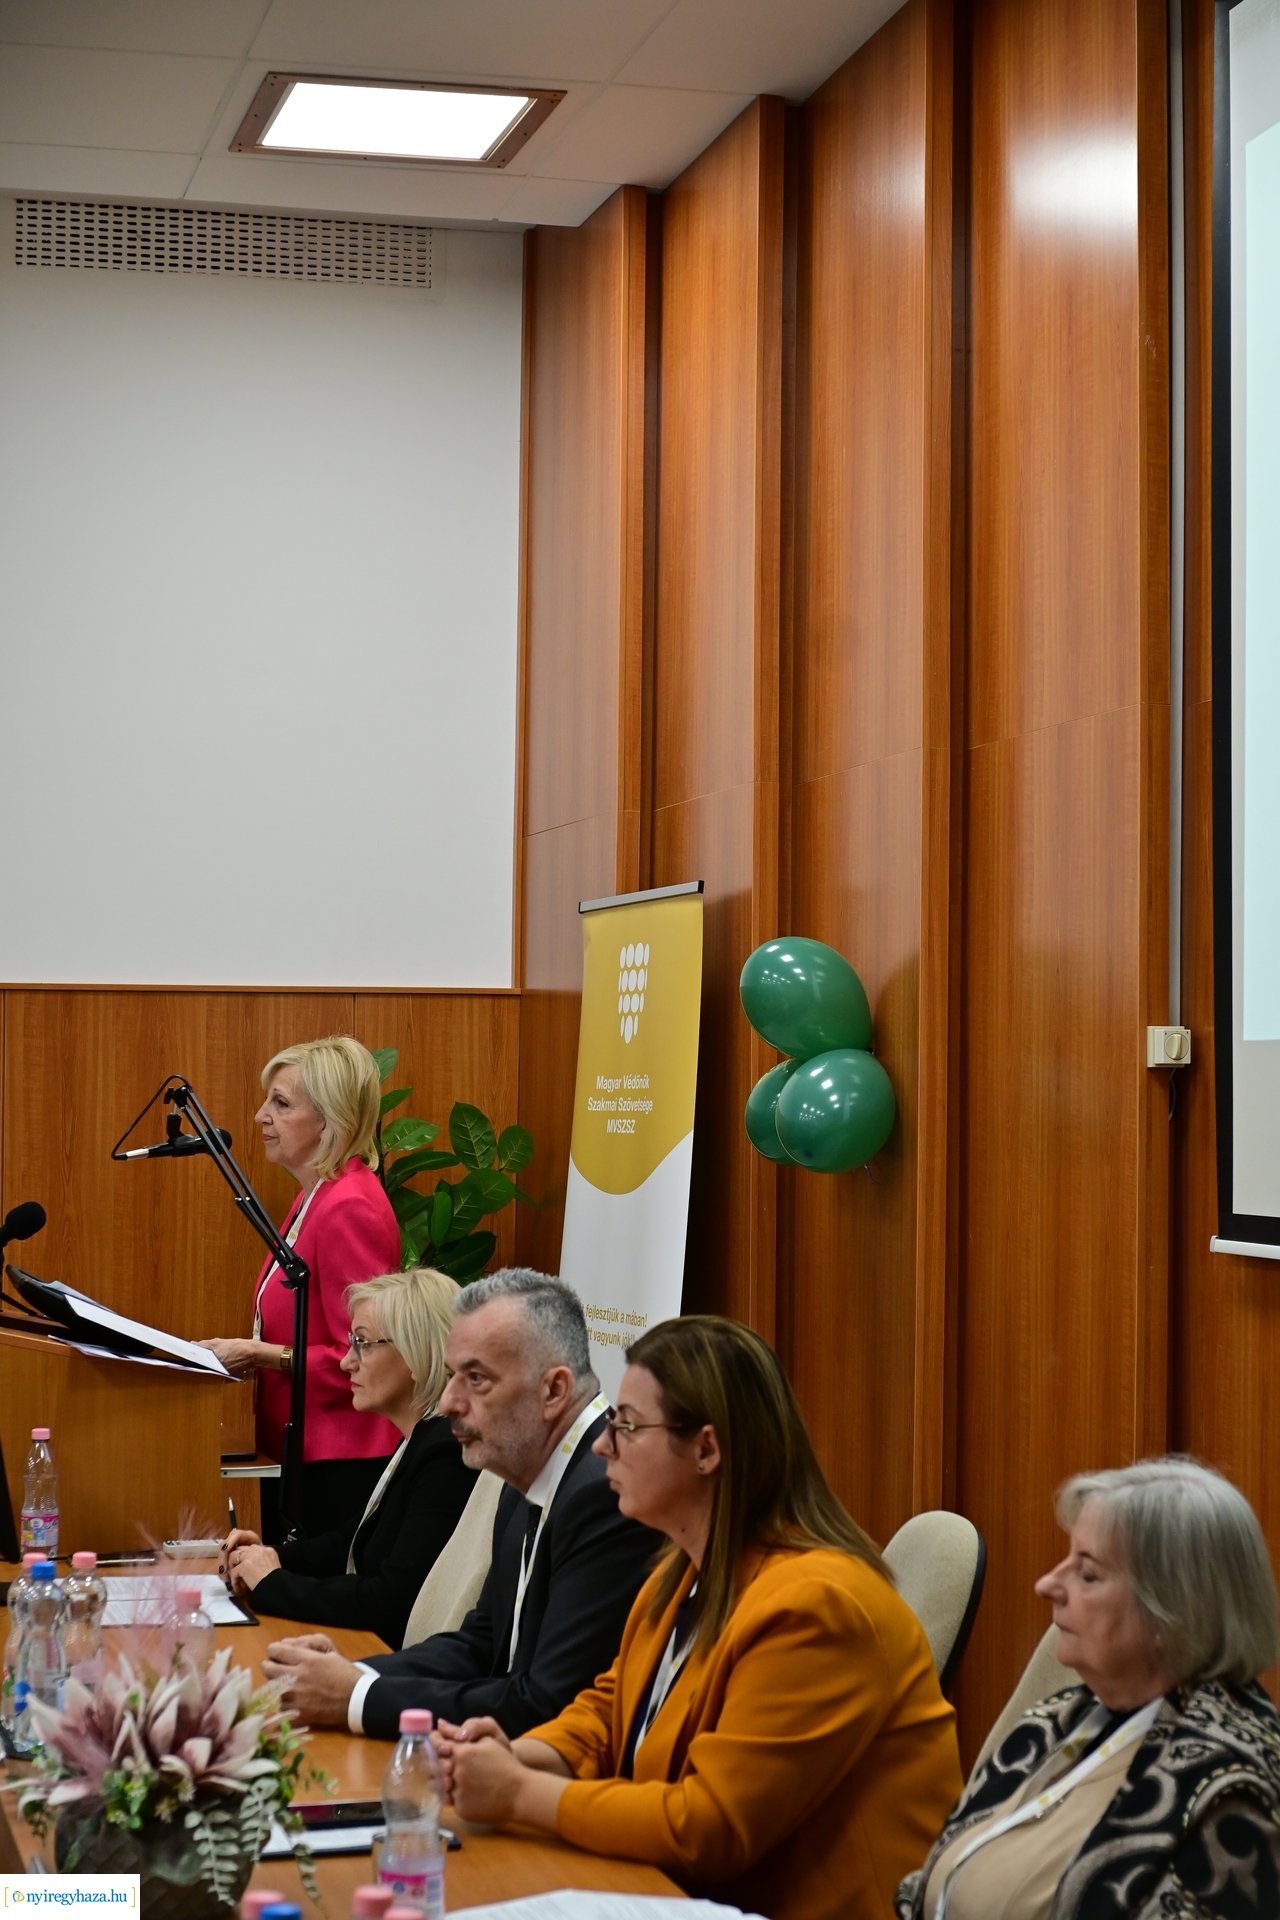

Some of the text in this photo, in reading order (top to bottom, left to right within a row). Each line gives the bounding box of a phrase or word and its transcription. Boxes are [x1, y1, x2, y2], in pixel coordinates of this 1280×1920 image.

[596, 1075, 622, 1093] Magyar
[587, 1096, 653, 1115] Szakmai Szövetsége
[607, 1119, 636, 1134] MVSZSZ
[585, 1304, 620, 1324] fejlesztjük
[620, 1312, 625, 1323] a
[593, 1330, 621, 1346] vagyunk
